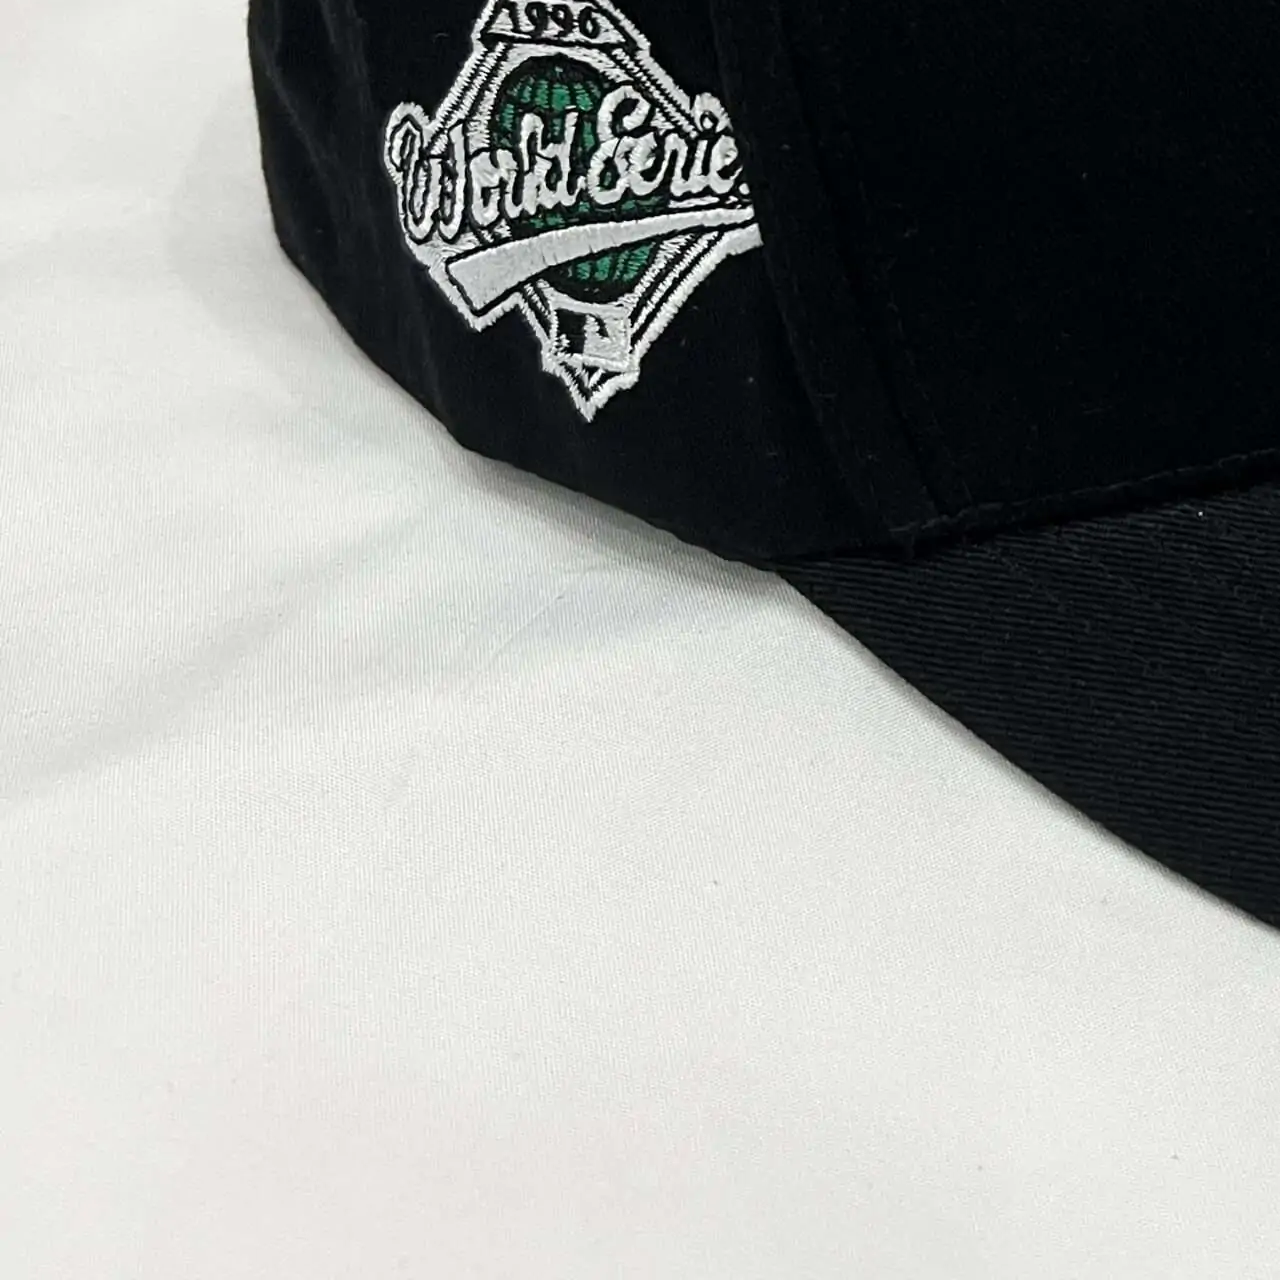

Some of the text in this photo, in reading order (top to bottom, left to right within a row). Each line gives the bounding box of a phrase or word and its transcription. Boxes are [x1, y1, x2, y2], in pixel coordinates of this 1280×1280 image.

[508, 0, 601, 40] 1996
[388, 84, 754, 236] World Serie
